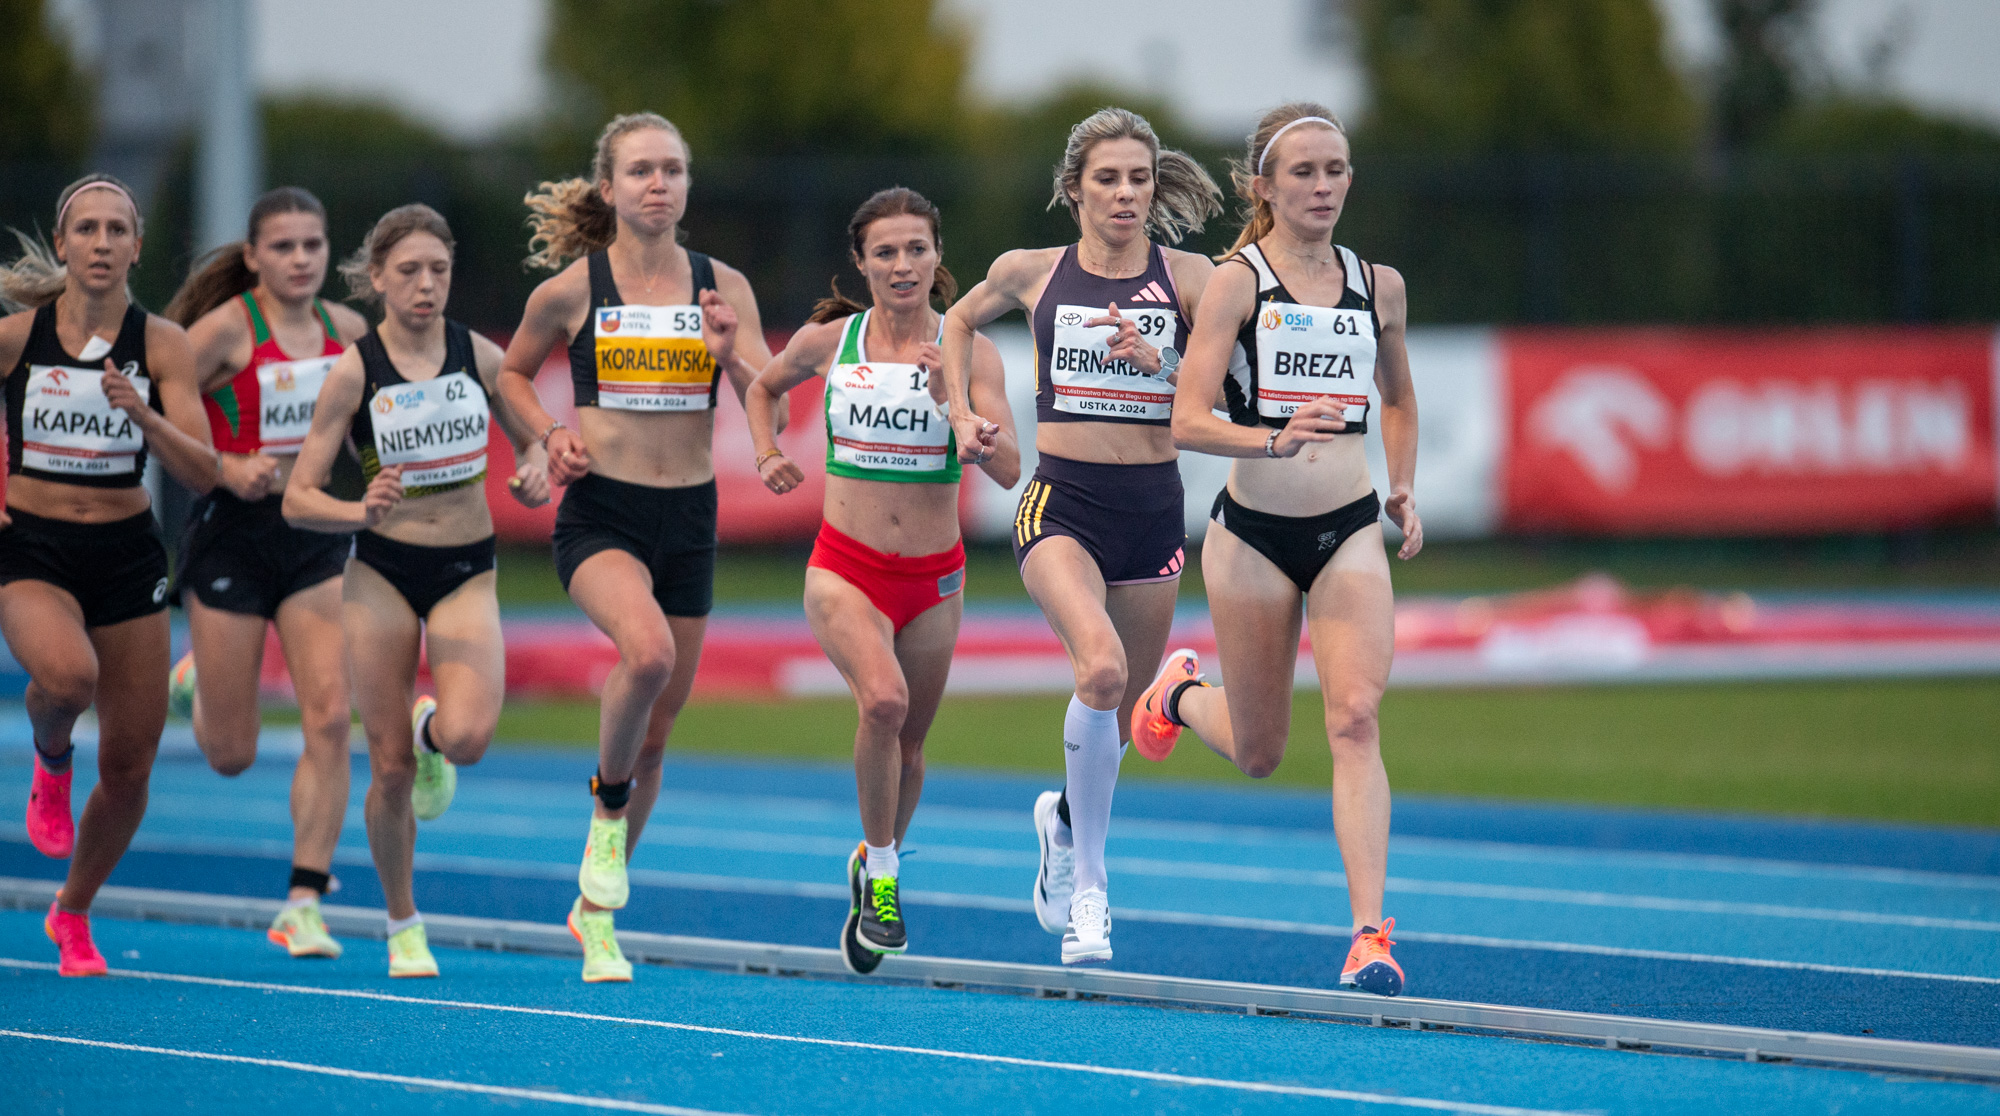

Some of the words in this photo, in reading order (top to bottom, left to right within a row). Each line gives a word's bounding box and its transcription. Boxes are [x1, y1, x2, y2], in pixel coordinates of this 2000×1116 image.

[673, 312, 701, 331] 53
[1138, 314, 1166, 336] 39
[1285, 313, 1313, 327] OSiR
[1333, 314, 1360, 336] 61
[601, 348, 711, 372] KORALEWSKA
[1273, 351, 1355, 380] BREZA
[41, 387, 71, 397] ORLEN
[445, 381, 468, 402] 62
[845, 382, 875, 390] ORLEN
[909, 371, 928, 392] 1
[626, 397, 661, 406] USTKA
[663, 397, 687, 406] 2024
[1080, 401, 1117, 411] USTKA
[1119, 403, 1147, 414] 2024
[33, 407, 132, 439] KAPAŁA
[849, 403, 929, 432] MACH
[380, 414, 486, 454] NIEMYJSKA
[48, 458, 82, 469] USTKA
[855, 453, 888, 464] USTKA
[891, 456, 918, 467] 2024
